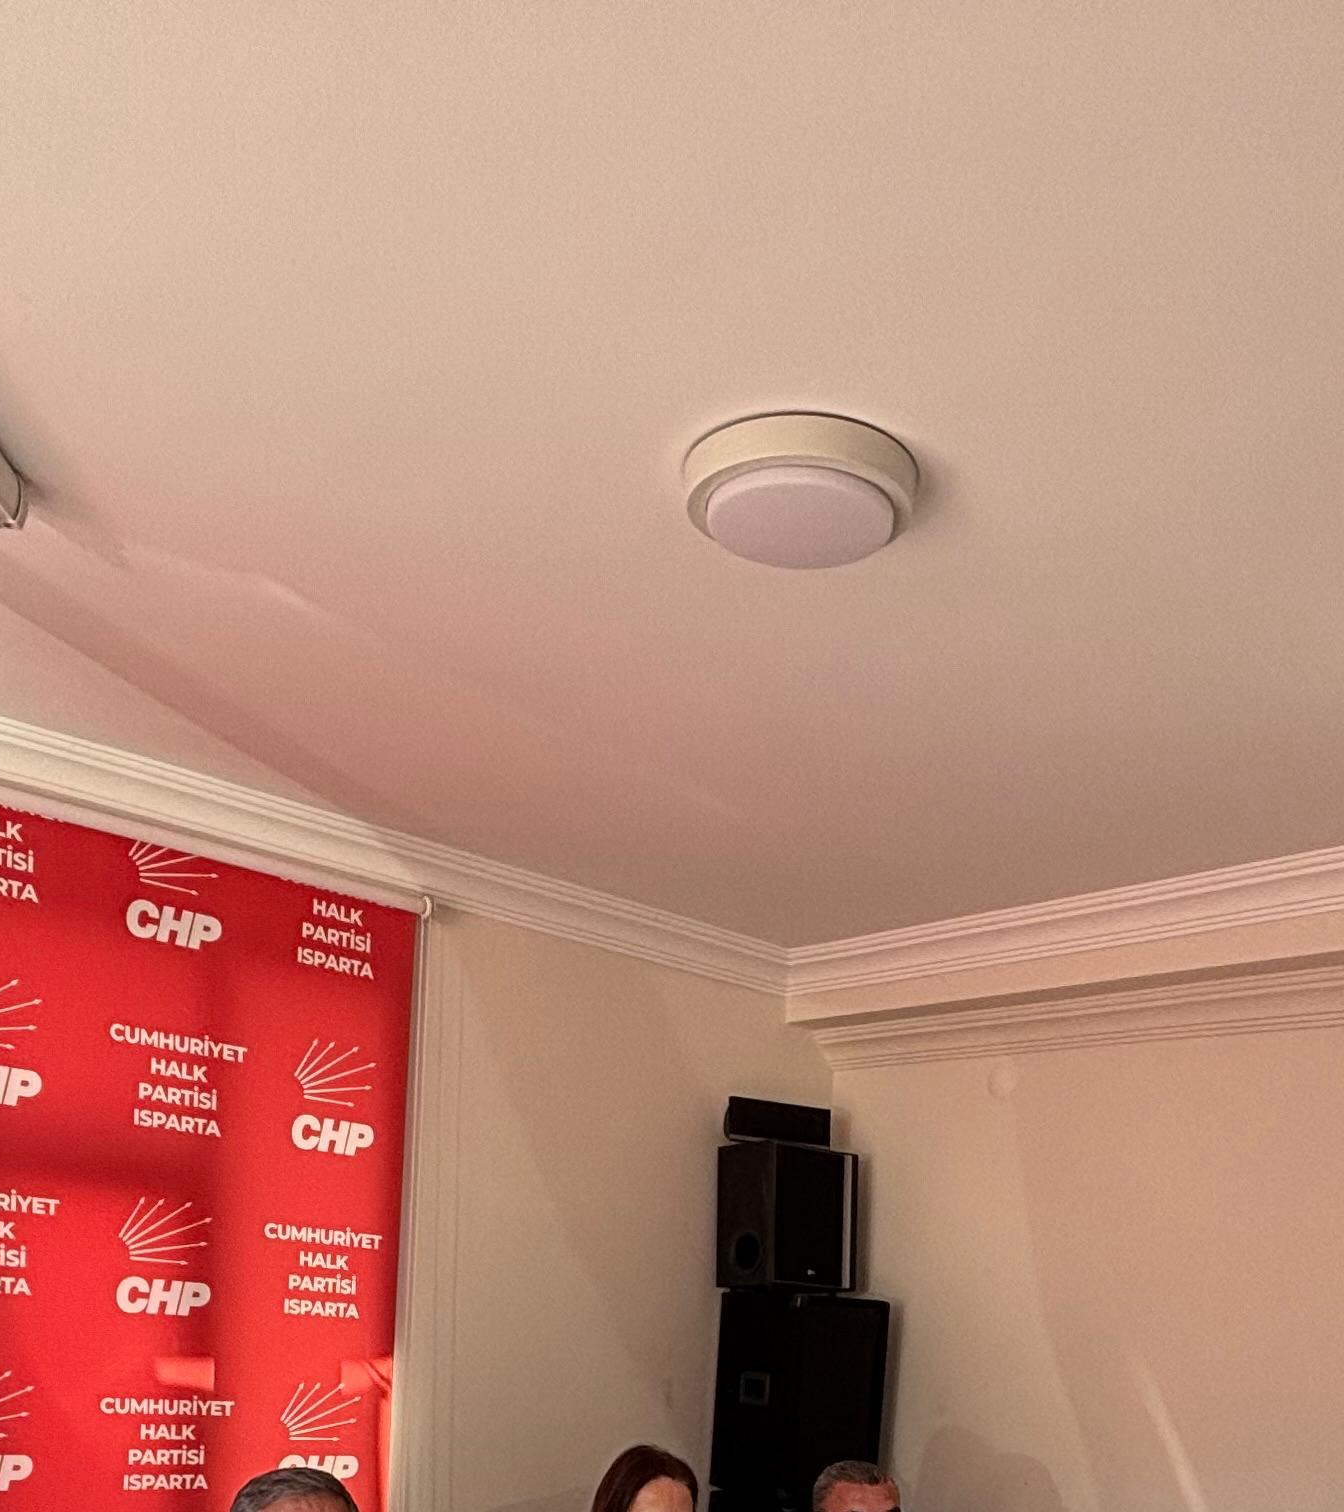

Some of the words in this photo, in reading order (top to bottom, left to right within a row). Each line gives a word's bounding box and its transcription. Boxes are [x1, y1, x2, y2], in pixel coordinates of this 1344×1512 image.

[127, 900, 222, 949] CHP
[313, 899, 363, 926] HALK
[302, 922, 371, 953] PARTİSİ
[298, 947, 373, 979] ISPARTA
[110, 1024, 247, 1062] CUMHURİYET
[151, 1058, 207, 1082] HALK
[139, 1083, 216, 1110] PARTİSİ
[134, 1109, 221, 1137] ISPARTA
[292, 1115, 374, 1156] CHP
[264, 1223, 382, 1249] CUMHURİYET
[300, 1251, 348, 1270] HALK
[116, 1276, 210, 1316] CHP
[289, 1274, 356, 1294] PARTİSİ
[284, 1299, 359, 1318] ISPARTA
[100, 1396, 235, 1416] CUMHURİYET
[140, 1424, 195, 1440] HALK
[129, 1445, 204, 1465] PARTİSİ
[123, 1474, 208, 1490] ISPARTA
